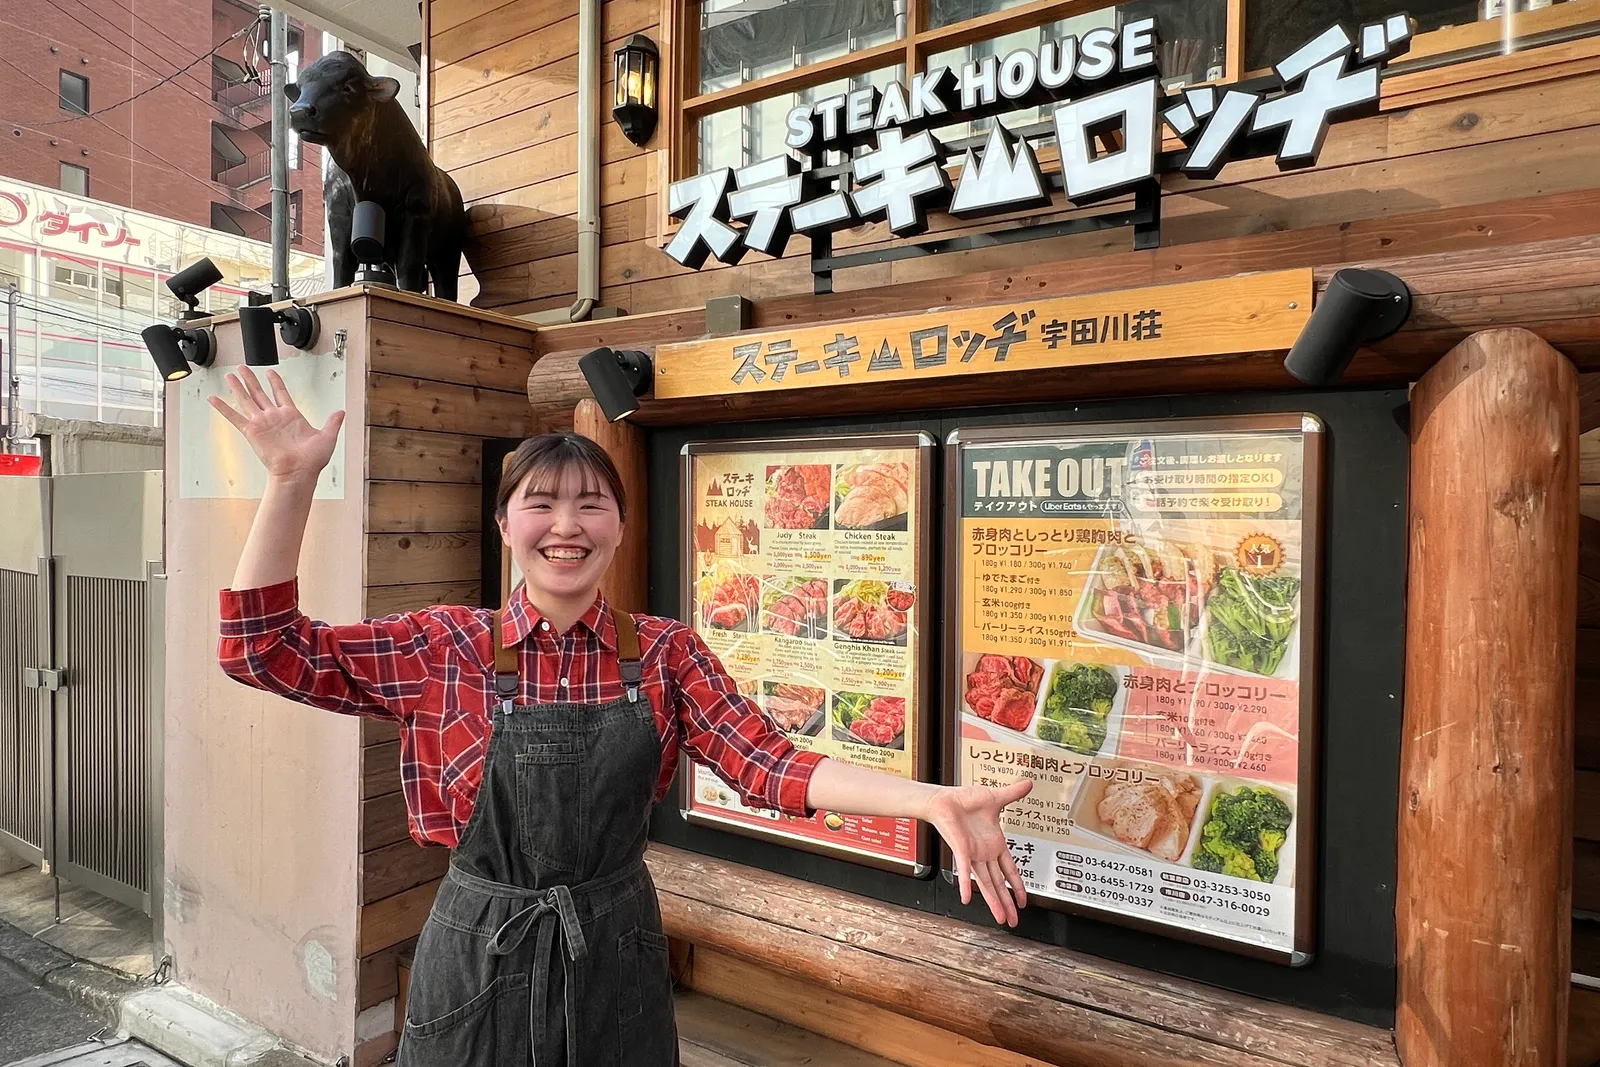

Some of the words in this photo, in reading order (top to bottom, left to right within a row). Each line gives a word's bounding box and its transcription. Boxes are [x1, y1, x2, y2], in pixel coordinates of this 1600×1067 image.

[786, 69, 944, 149] STEAK
[962, 17, 1158, 108] HOUSE
[1040, 310, 1162, 349] 宇田川荘
[723, 472, 754, 484] ステーキ
[972, 460, 1050, 497] TAKE
[1057, 457, 1128, 498] OUT
[705, 499, 728, 508] STEAK
[730, 499, 753, 508] HOUSE
[973, 500, 1037, 512] テイクアウト
[1145, 496, 1270, 508] 話予約で楽々受け取り!
[799, 531, 817, 540] Steak
[844, 532, 872, 540] Chicken
[876, 532, 896, 541] Steak
[972, 527, 1137, 544] 赤身肉としっとり鶏胸肉と
[972, 543, 1048, 557] ブロッコリー
[1249, 543, 1272, 554] 人気
[982, 559, 998, 568] 180g
[1029, 561, 1046, 570] 300g
[982, 573, 1041, 584] ゆでたまご付き
[982, 585, 998, 594] 180g
[1030, 587, 1047, 597] 300g
[982, 597, 1031, 610] 玄米100g付き
[982, 610, 998, 619] 180g
[1029, 612, 1047, 623] 300g
[712, 630, 727, 638] Fresh
[982, 622, 1078, 638] バーリーライス150g付き
[774, 637, 803, 647] Kangaroo
[982, 634, 998, 643] 180g
[1029, 637, 1047, 647] 300g
[834, 642, 861, 652] Genghis
[862, 645, 880, 653] Khan
[1155, 695, 1175, 707] 180g
[1213, 701, 1235, 713] 300g
[1155, 710, 1216, 727] 玄米10g付き
[799, 736, 813, 745] 200g
[1213, 730, 1235, 742] 300g
[856, 745, 878, 755] Tendon
[879, 748, 895, 758] 200g
[1155, 737, 1273, 762] バーリーライス10g付き
[862, 754, 886, 764] Broccoli
[969, 745, 1160, 784] しっとり鶏胸肉とブロッコリー
[1155, 749, 1175, 762] 180g
[1213, 756, 1235, 770] 300g
[979, 763, 996, 774] 150g
[997, 766, 1014, 776] ¥870
[1020, 770, 1038, 781] 300g
[1026, 797, 1044, 809] 300g
[1027, 821, 1044, 833] 300g
[1006, 838, 1035, 855] テーキ
[1020, 868, 1035, 879] USE
[1085, 856, 1153, 878] 03-6427-0581
[1085, 872, 1154, 893] 03-6455-1729
[1084, 885, 1154, 908] 03-6709-0337
[1193, 879, 1271, 902] 03-3253-3050
[1192, 893, 1270, 917] 047-316-0029
